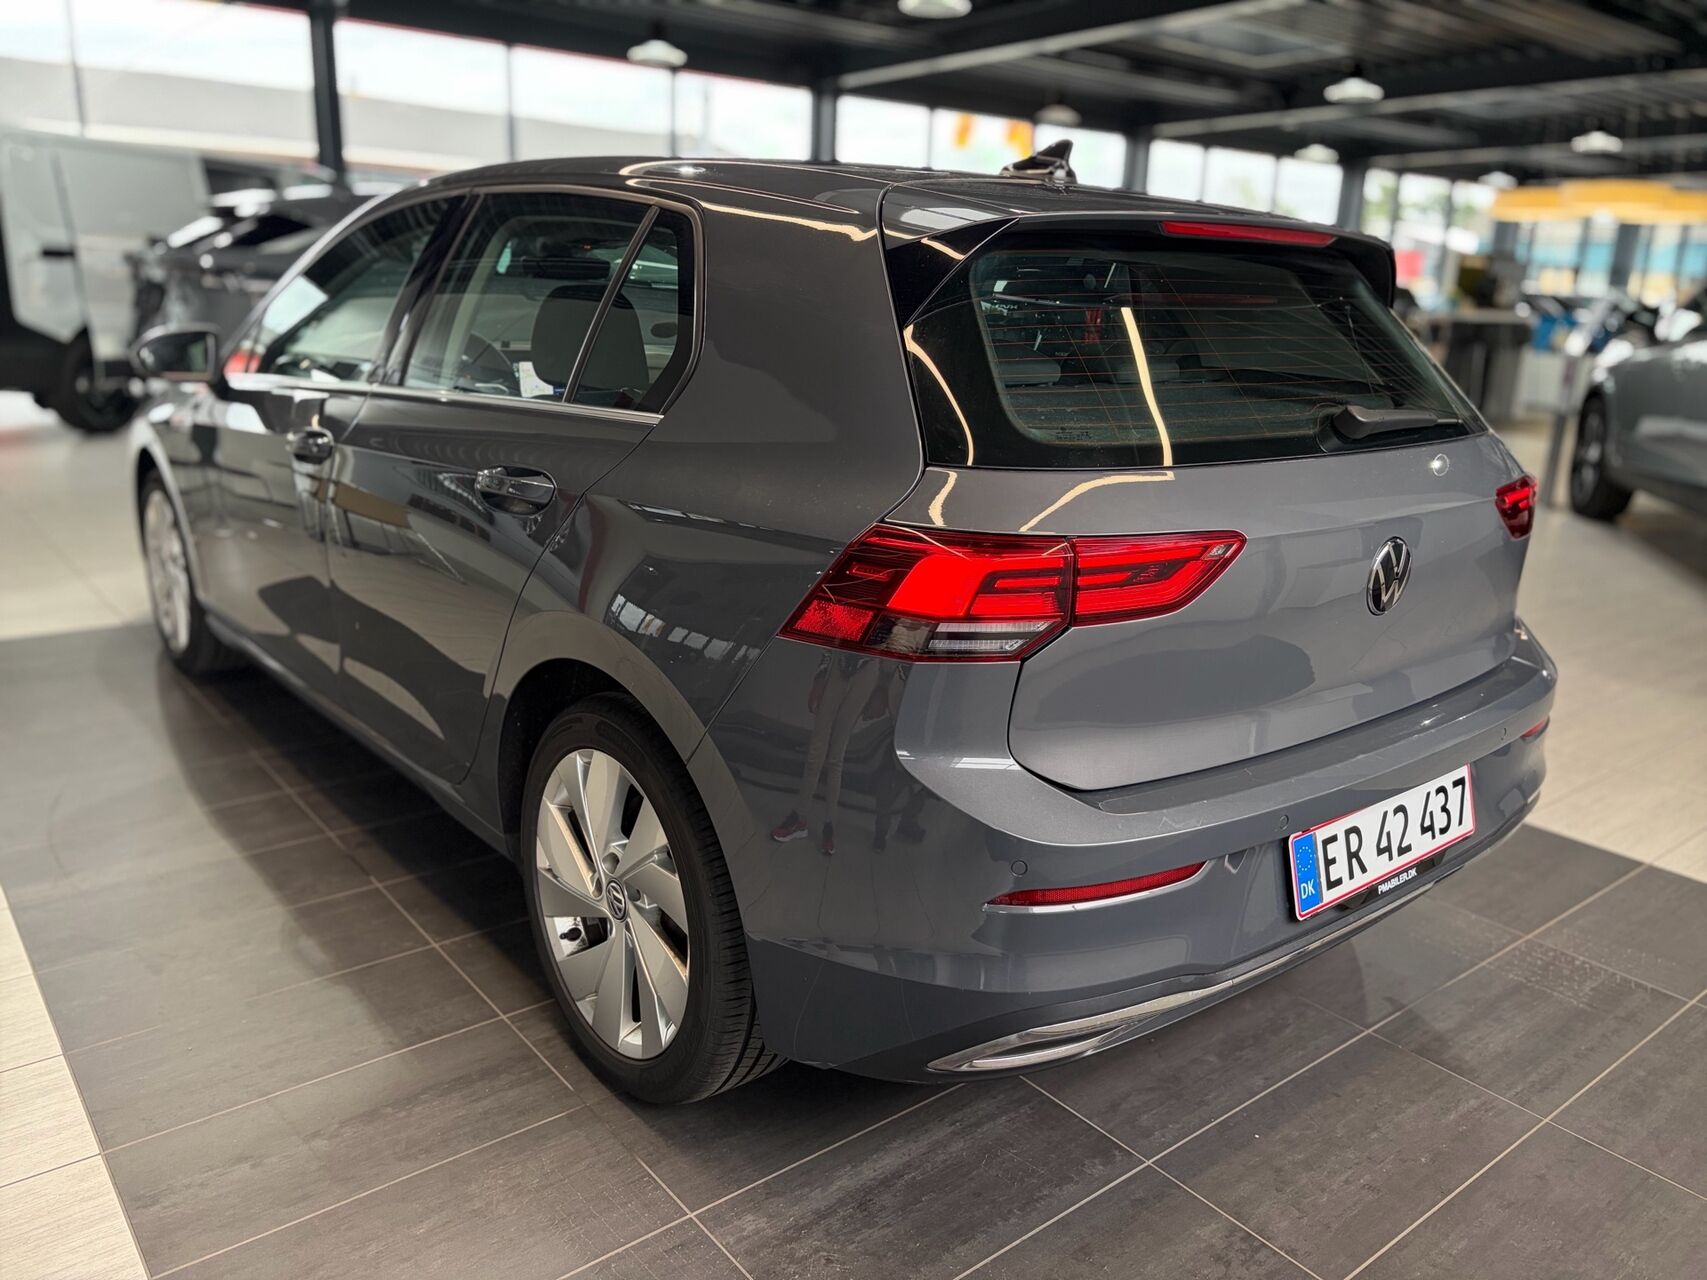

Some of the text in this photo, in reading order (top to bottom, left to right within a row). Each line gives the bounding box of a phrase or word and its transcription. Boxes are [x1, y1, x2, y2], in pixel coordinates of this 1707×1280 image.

[1322, 776, 1466, 891] ER 42 437
[1301, 879, 1316, 899] DK
[1378, 867, 1418, 895] PMABILER.DK
